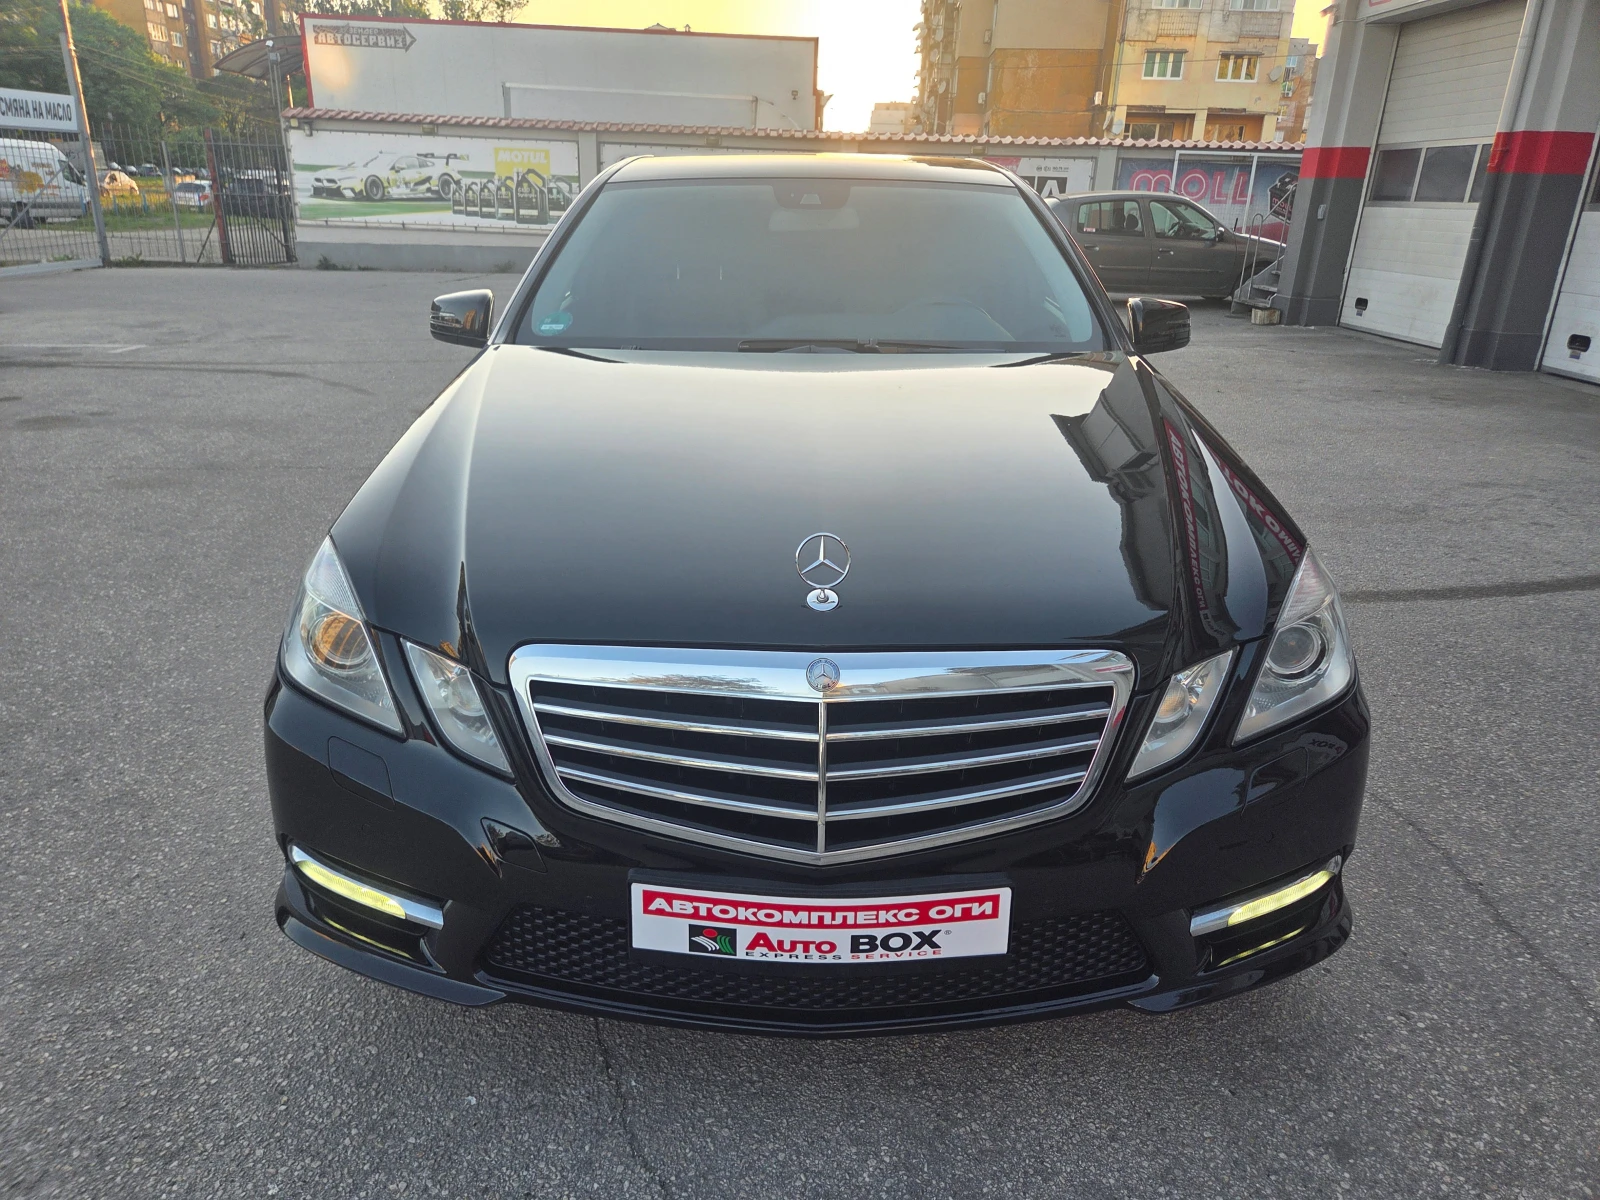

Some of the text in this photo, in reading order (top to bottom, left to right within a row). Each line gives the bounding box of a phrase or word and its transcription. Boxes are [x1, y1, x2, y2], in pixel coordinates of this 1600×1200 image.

[317, 32, 403, 48] АВТОСЕРВИЗ
[0, 96, 73, 122] СМЯНА НА МАСЛО
[498, 150, 548, 164] MOTUL
[647, 897, 994, 926] АВТОКОМПЛЕКС ОГИ
[745, 949, 943, 961] EXPRESS SERVICE
